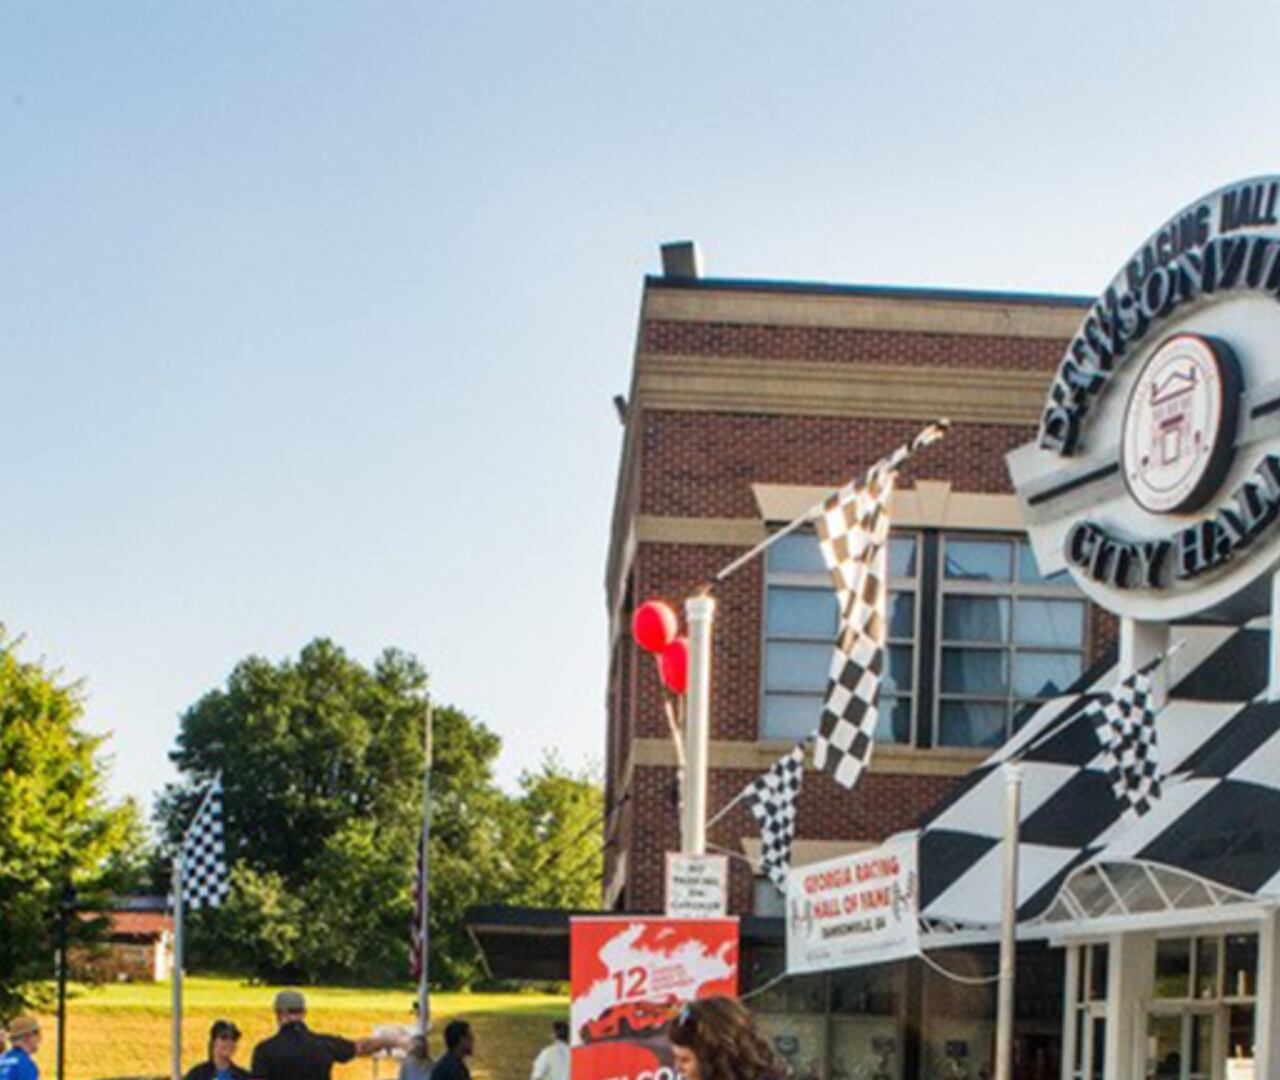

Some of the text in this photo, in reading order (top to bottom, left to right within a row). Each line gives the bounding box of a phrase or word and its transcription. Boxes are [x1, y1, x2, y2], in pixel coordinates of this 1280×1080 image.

[1126, 204, 1211, 290] RACING
[1219, 183, 1279, 233] HALL
[1066, 520, 1173, 588] CITY
[804, 856, 900, 893] GEORGIA RACING
[812, 887, 890, 918] HALL OF FAME
[613, 966, 648, 999] 12
